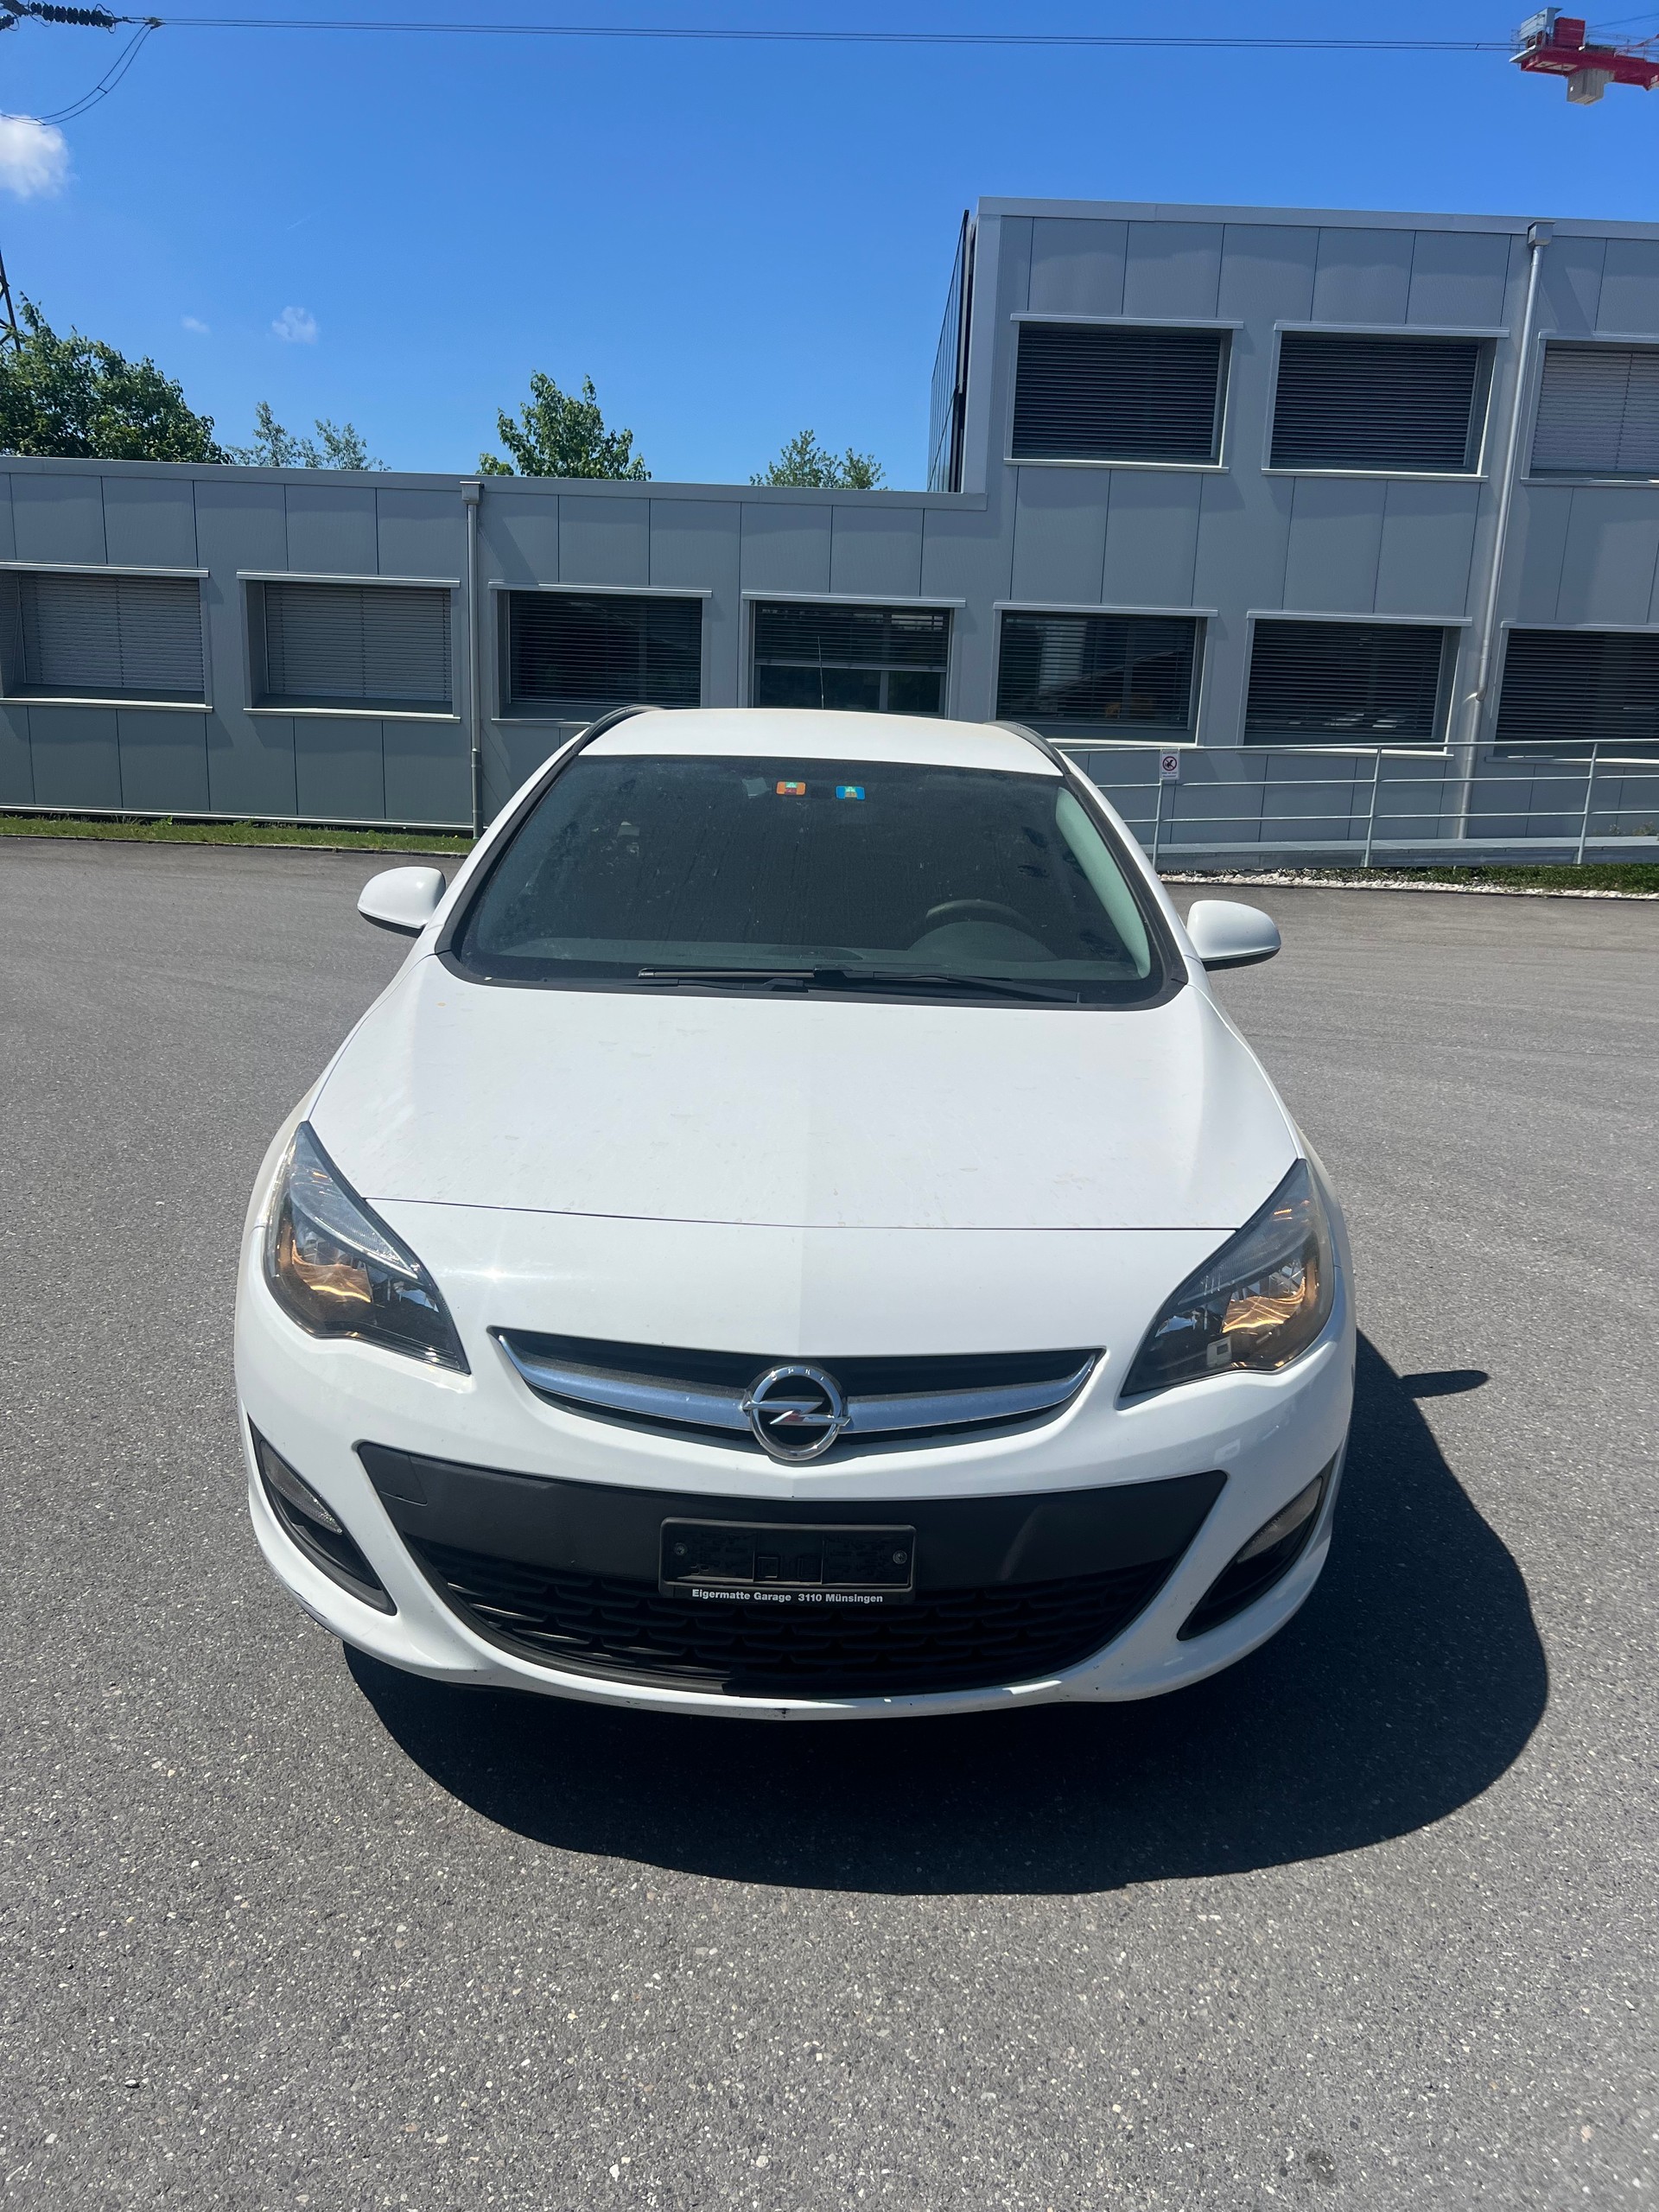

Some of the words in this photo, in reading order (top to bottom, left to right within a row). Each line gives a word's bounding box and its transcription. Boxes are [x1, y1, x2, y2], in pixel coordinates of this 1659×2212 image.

[691, 1588, 751, 1601] Eigermatte
[753, 1592, 791, 1603] Garage
[798, 1593, 823, 1602] 3110
[825, 1592, 883, 1604] Münsingen
